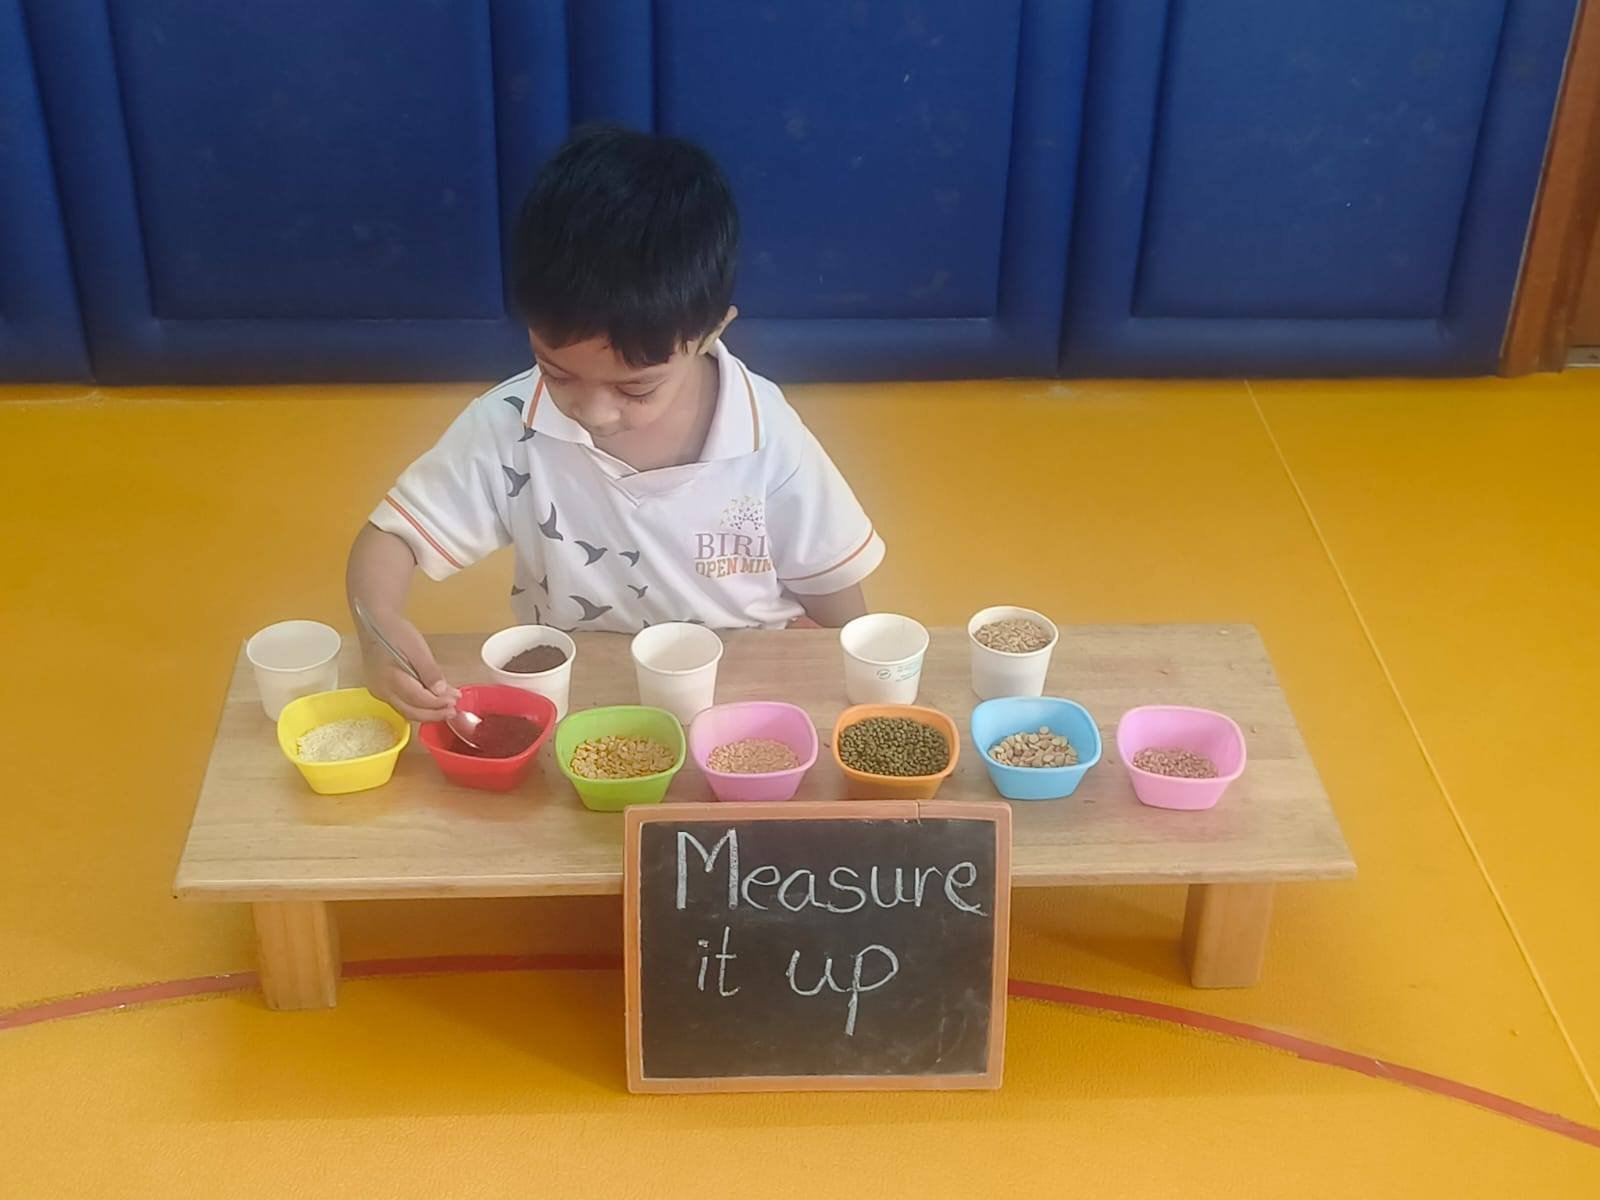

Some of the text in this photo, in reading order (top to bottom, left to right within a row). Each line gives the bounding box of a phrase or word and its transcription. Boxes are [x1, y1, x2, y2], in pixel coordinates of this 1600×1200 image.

[695, 557, 737, 578] OPEN
[676, 828, 987, 917] Measure
[697, 926, 899, 1036] it up
